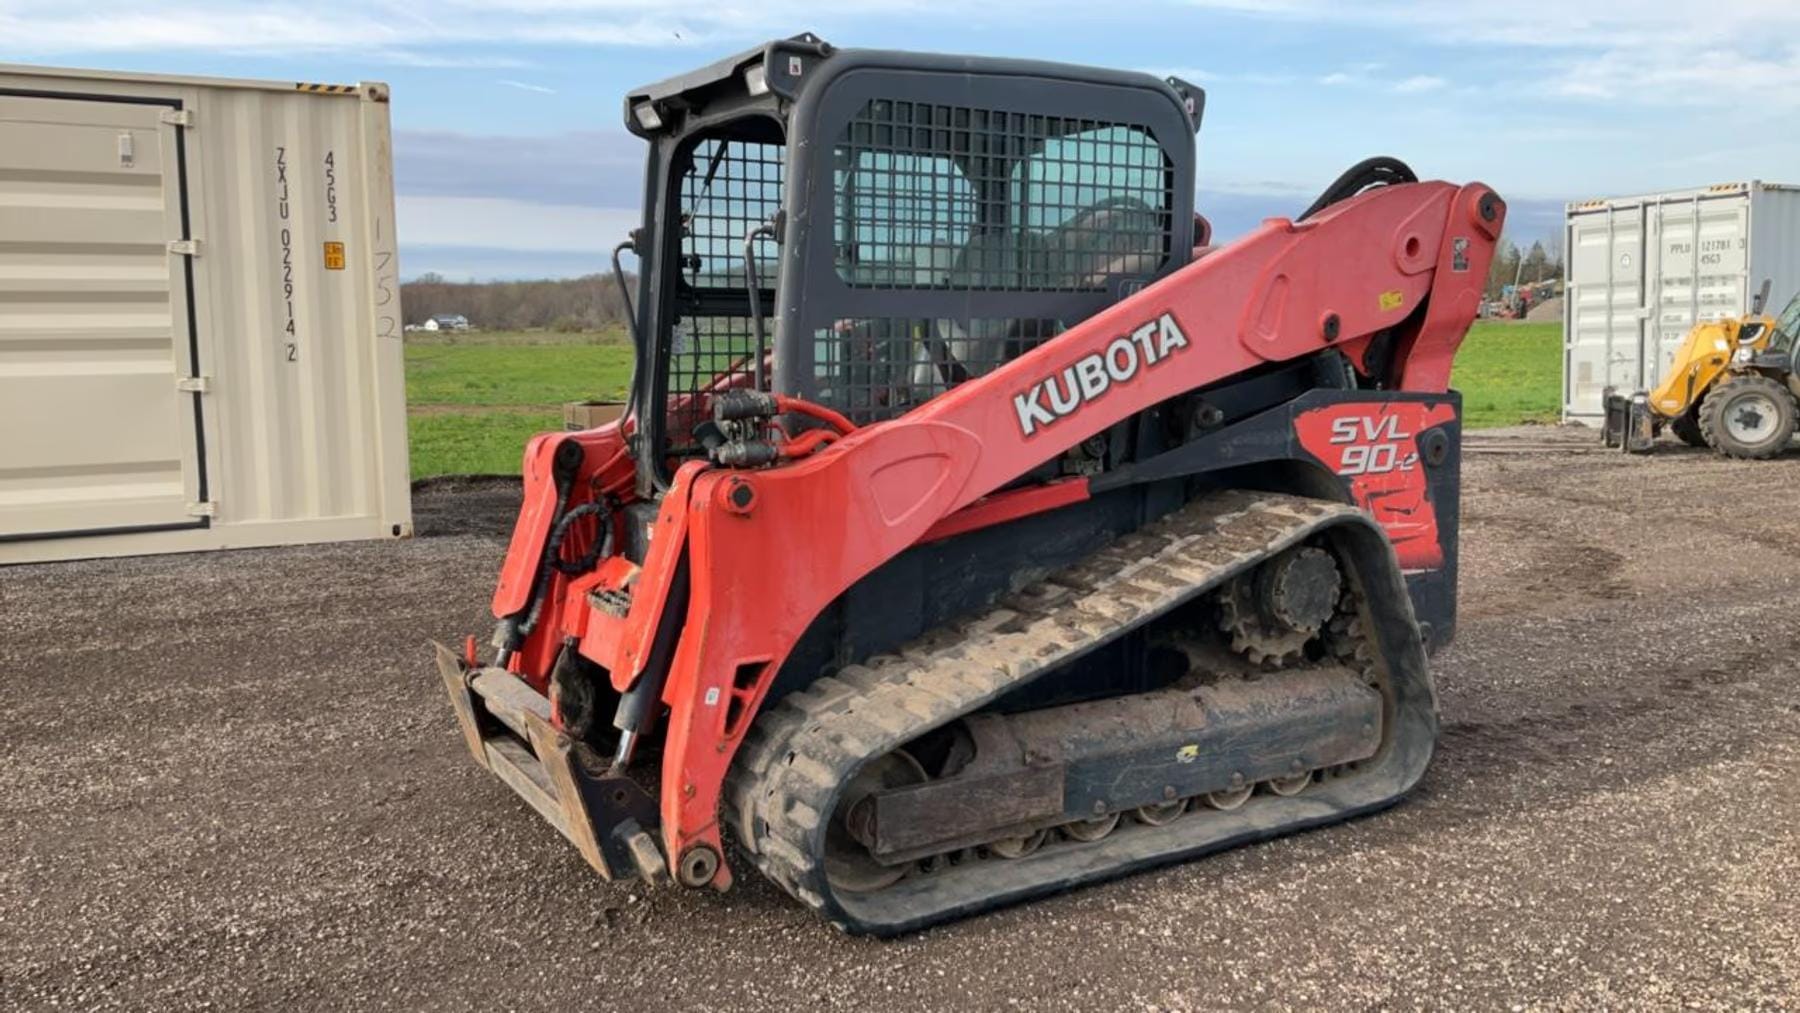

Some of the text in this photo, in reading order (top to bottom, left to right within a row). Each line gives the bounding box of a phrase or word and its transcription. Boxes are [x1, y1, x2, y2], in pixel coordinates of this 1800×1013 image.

[324, 151, 337, 223] 45G3
[276, 147, 297, 362] ZXJU 022914 2
[1013, 313, 1189, 437] KUBOTA
[1329, 414, 1411, 444] SVL
